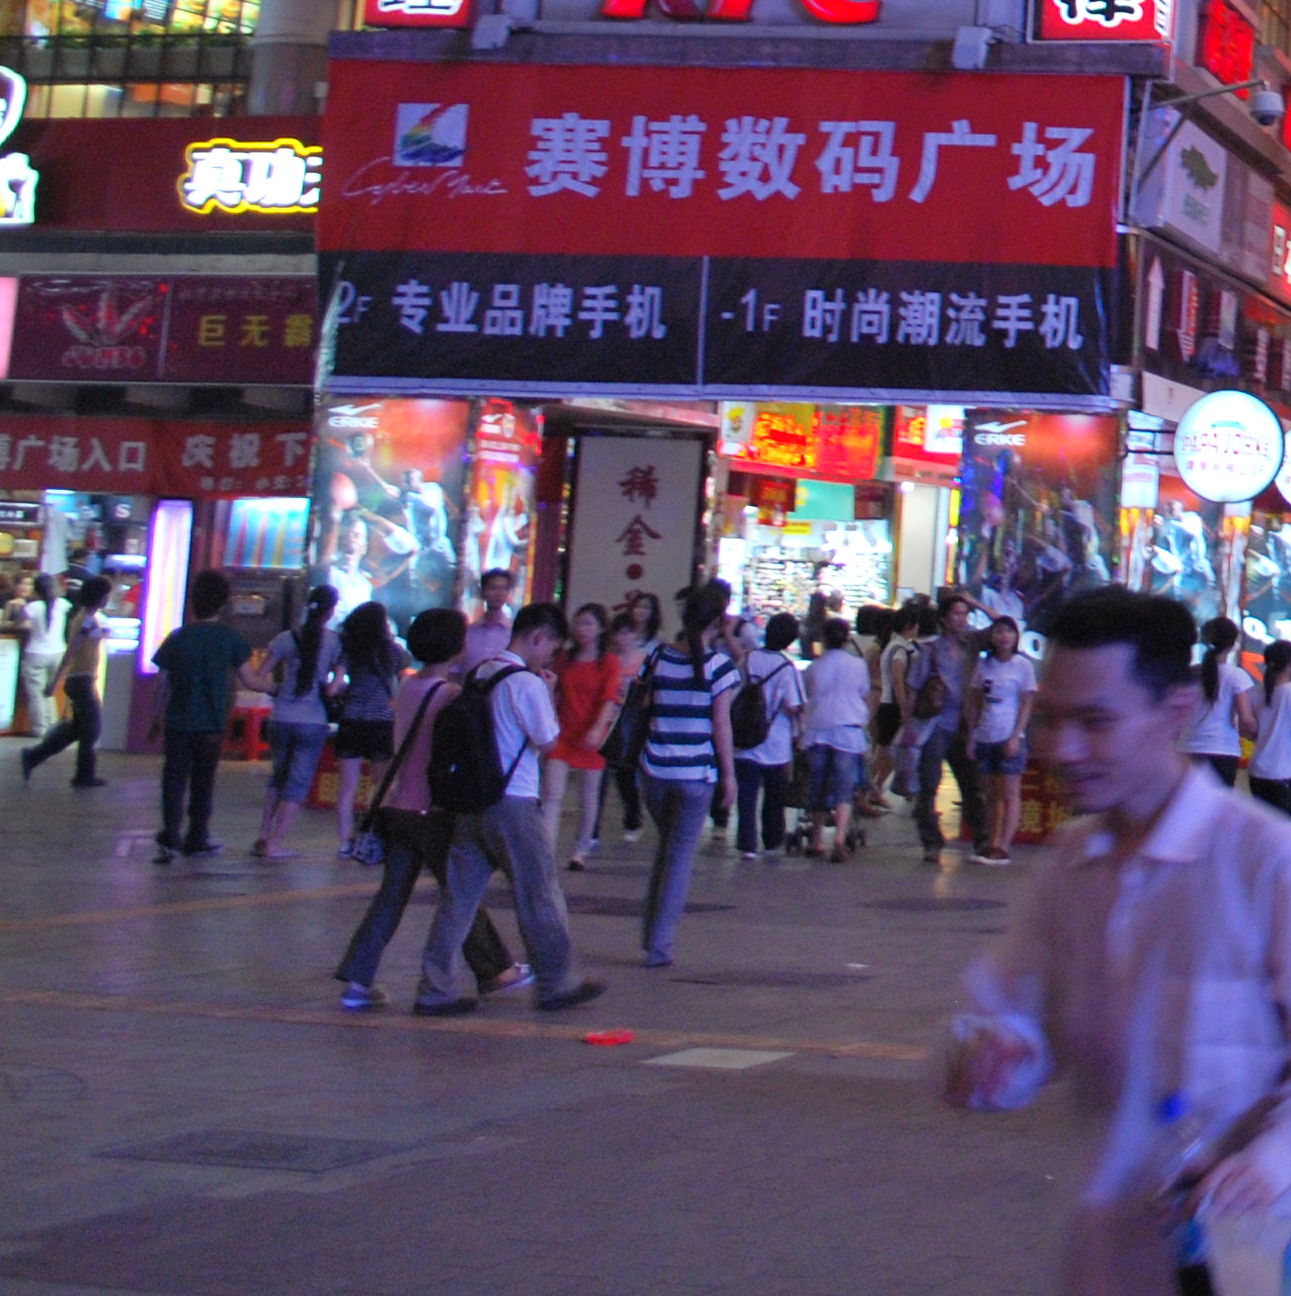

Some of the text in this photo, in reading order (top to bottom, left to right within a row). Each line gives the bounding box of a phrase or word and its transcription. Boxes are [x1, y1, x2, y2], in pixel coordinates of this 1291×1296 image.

[525, 113, 1098, 210] 赛博数码广场
[392, 280, 669, 342] 专业品牌手机
[802, 288, 1085, 352] 时尚潮流手机
